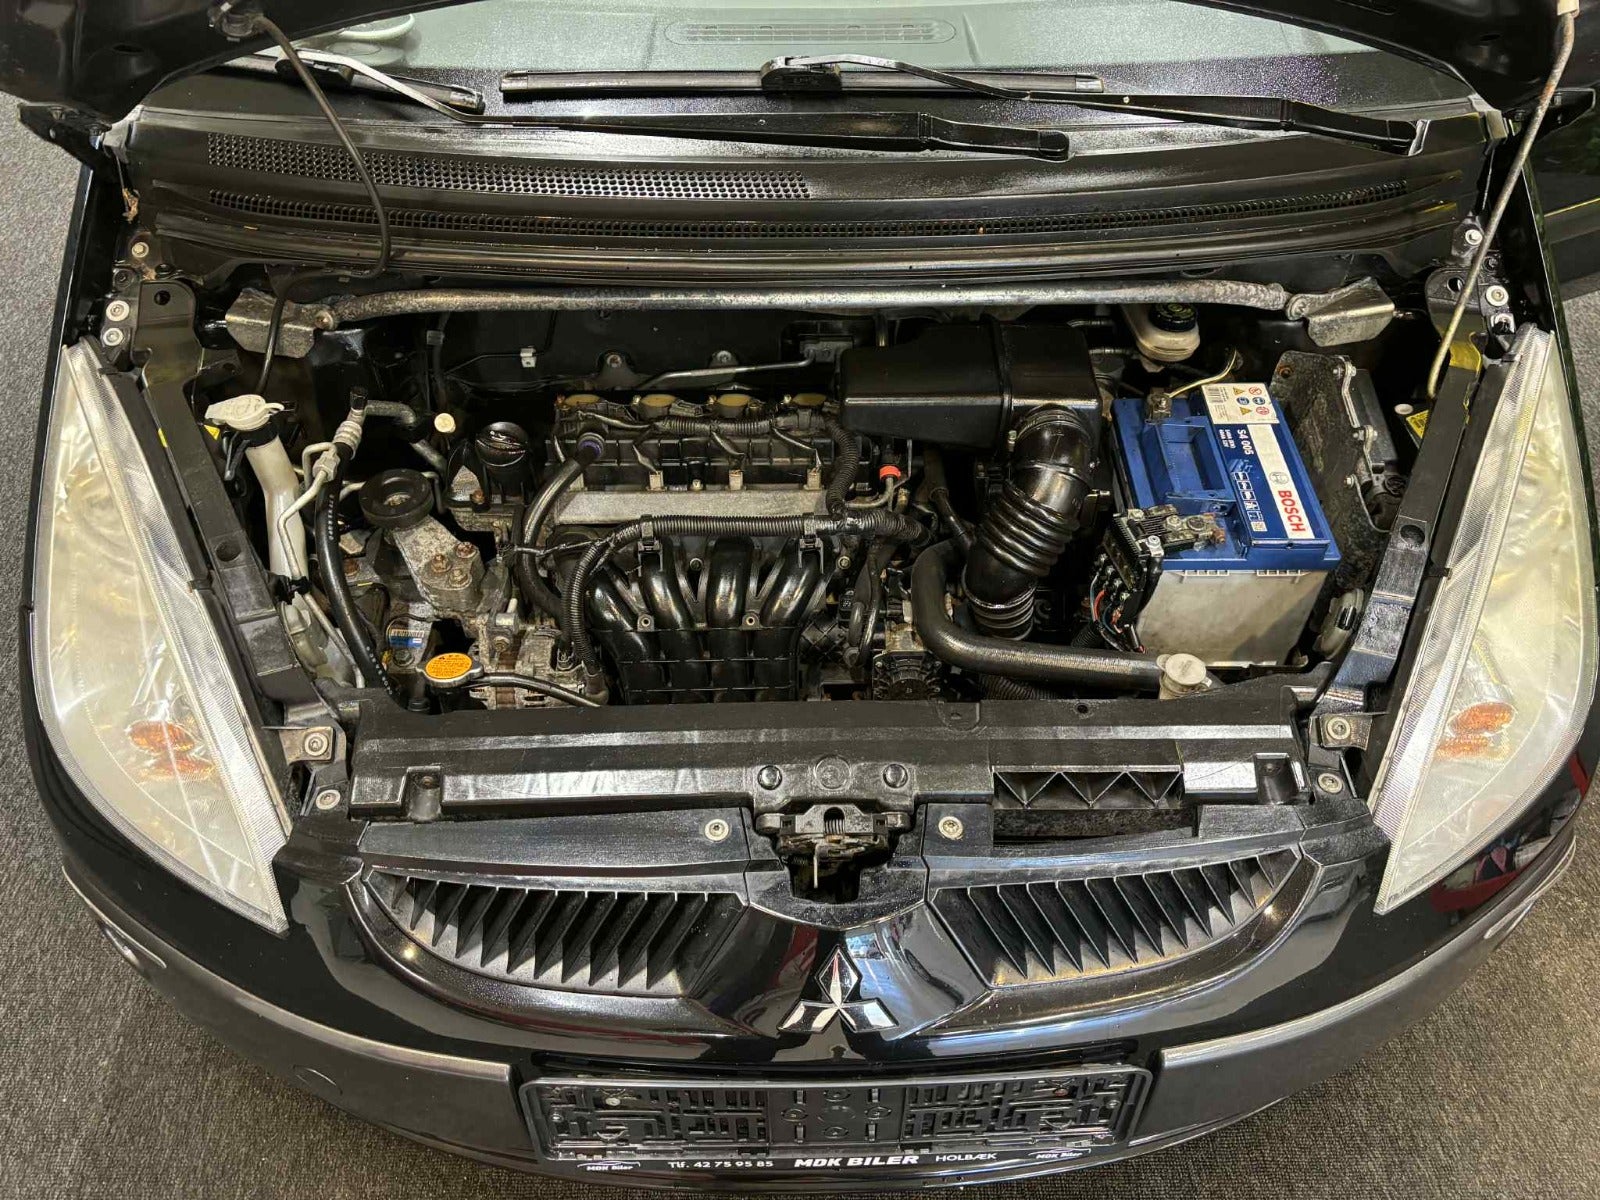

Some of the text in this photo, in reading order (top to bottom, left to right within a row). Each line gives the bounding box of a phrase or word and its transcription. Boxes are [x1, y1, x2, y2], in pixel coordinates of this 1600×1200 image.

[1237, 429, 1255, 455] S4 005
[1277, 490, 1307, 532] BOSCH
[667, 1161, 690, 1169] Tlf.
[794, 1158, 842, 1168] MDK
[846, 1155, 920, 1167] BILER
[935, 1152, 998, 1162] HOLBÆK
